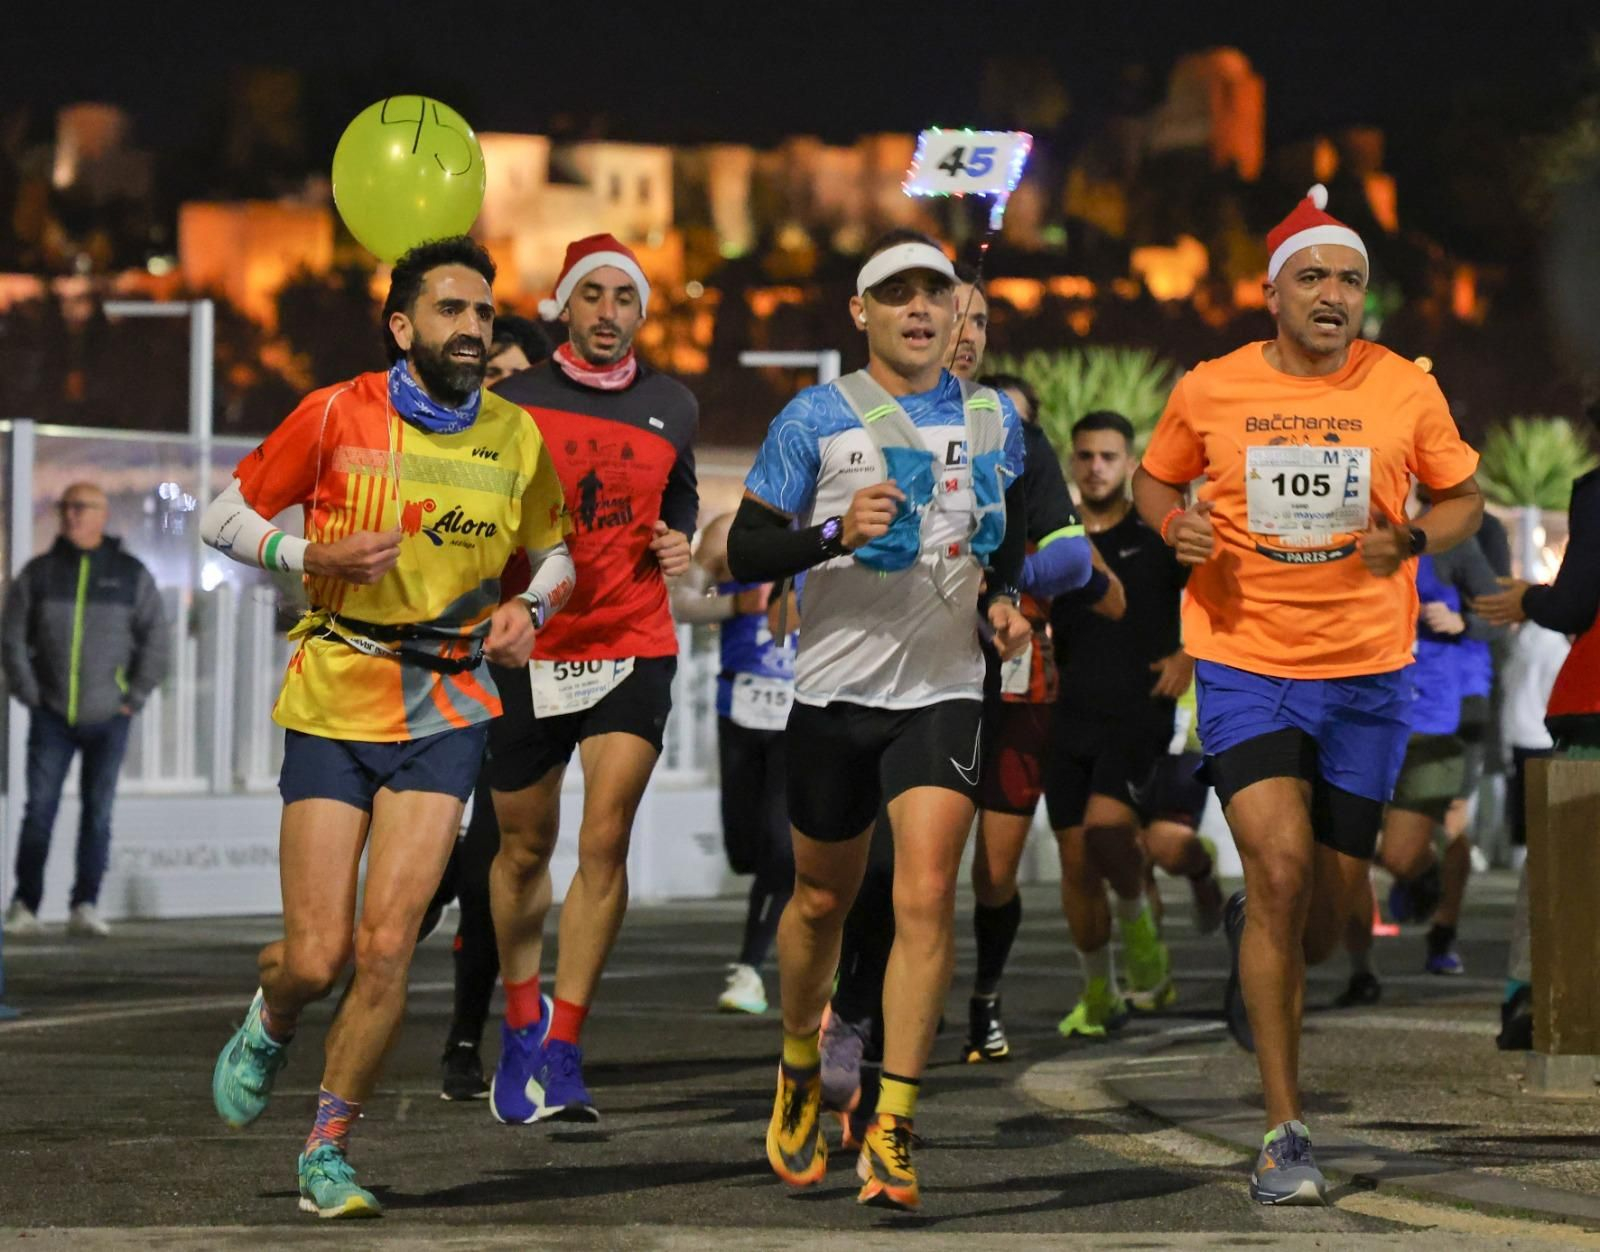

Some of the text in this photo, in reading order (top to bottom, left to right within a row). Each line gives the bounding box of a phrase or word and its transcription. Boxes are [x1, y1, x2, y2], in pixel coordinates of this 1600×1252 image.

[380, 97, 472, 175] 45
[938, 146, 997, 177] 45
[1246, 415, 1362, 433] Bacchantes
[1271, 473, 1331, 497] 105
[432, 505, 497, 538] Álora
[1287, 551, 1328, 564] PARIS
[553, 660, 603, 681] 590
[750, 689, 786, 706] 715
